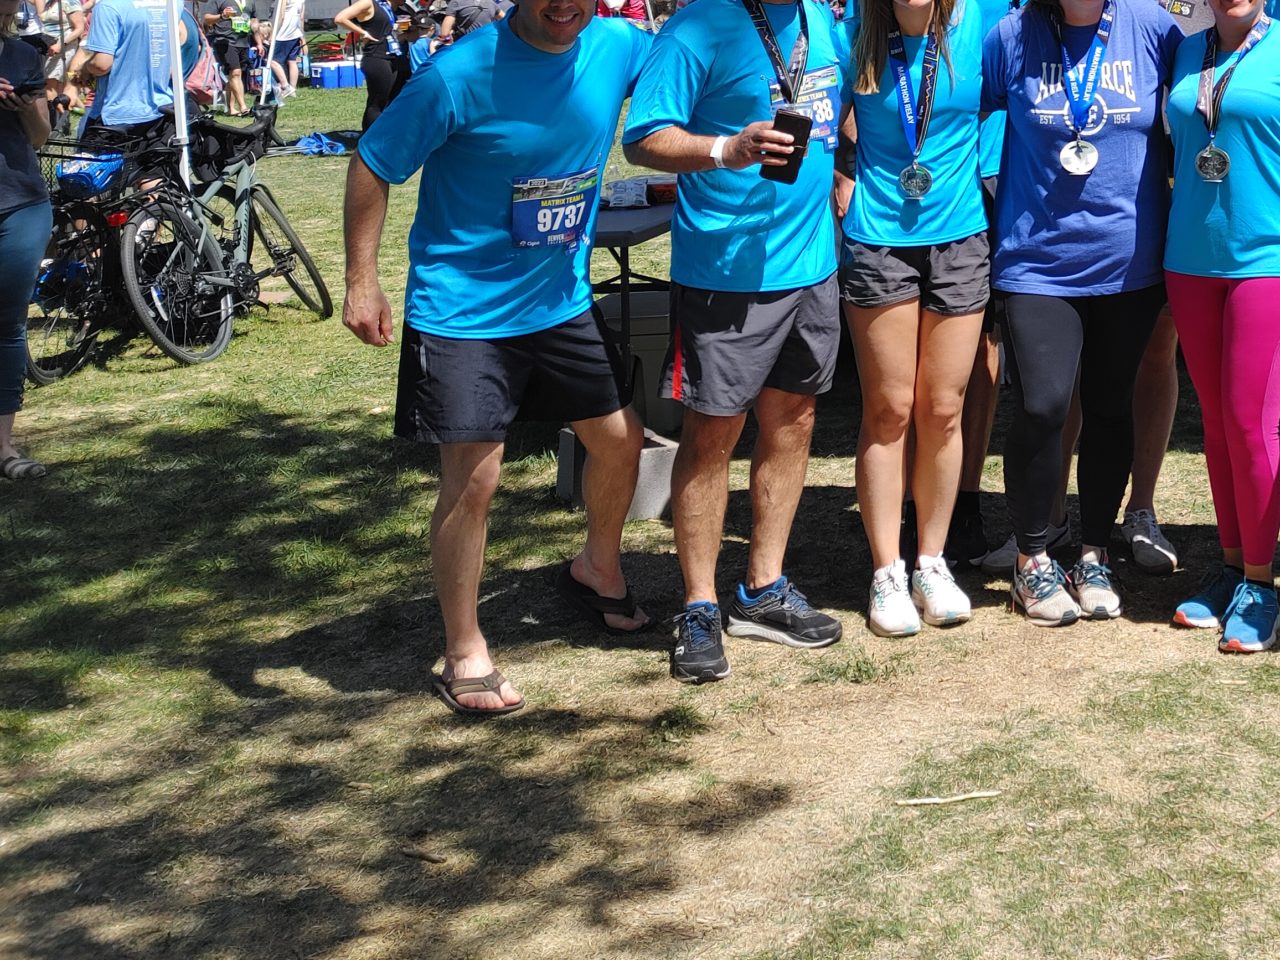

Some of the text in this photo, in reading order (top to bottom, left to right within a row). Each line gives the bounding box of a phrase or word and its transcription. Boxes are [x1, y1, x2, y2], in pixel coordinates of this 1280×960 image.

[1083, 46, 1103, 102] MARATHON RELAY
[896, 66, 915, 124] MARATHON RELAY
[1040, 115, 1056, 125] EST.
[1113, 113, 1131, 125] 1954
[541, 197, 566, 207] MATRIX
[566, 195, 580, 204] TEAM
[537, 201, 586, 232] 9737
